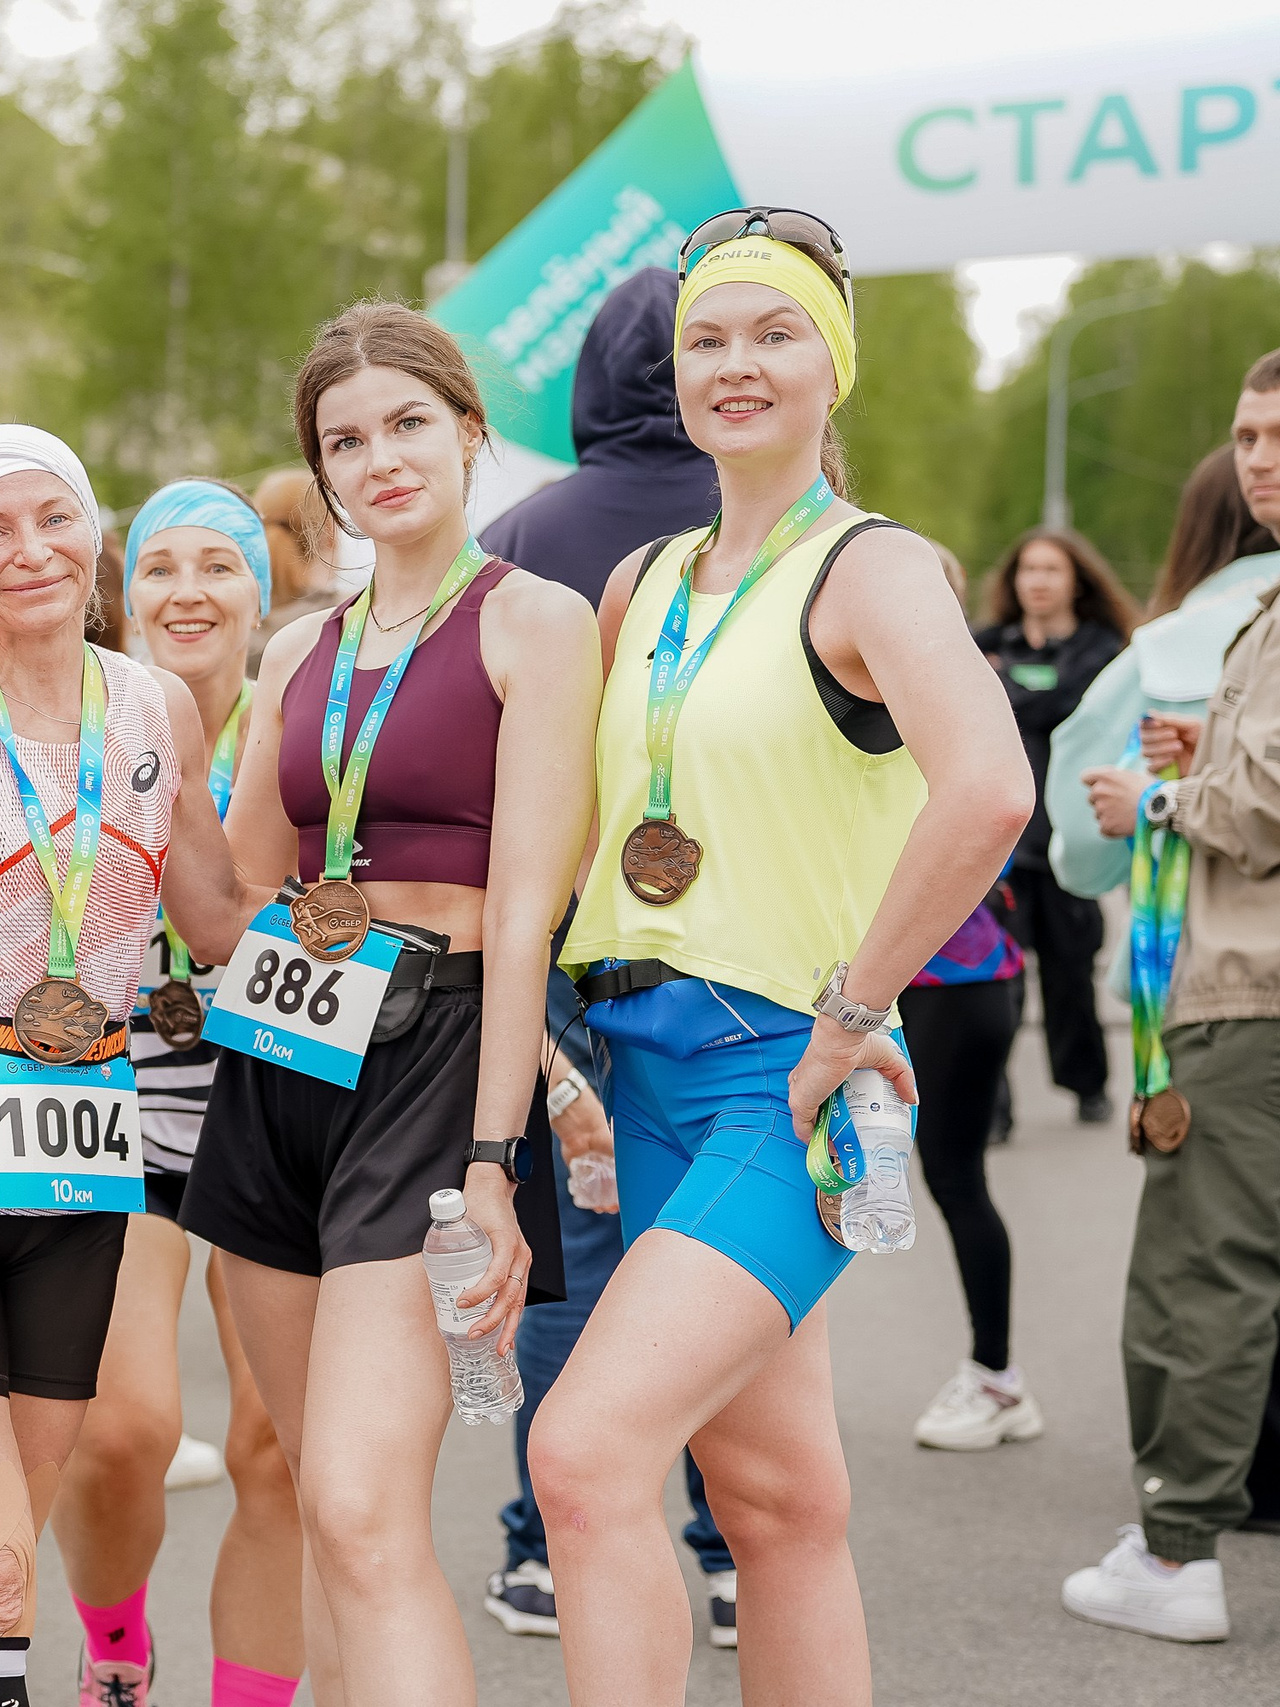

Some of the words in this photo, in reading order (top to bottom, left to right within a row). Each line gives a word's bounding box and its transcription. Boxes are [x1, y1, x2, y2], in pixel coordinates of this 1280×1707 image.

[898, 85, 1279, 191] СТАР
[794, 506, 812, 523] 185
[391, 657, 405, 678] Utair
[684, 650, 701, 678] СБЕР
[656, 664, 669, 693] СБЕР
[363, 710, 380, 739] СБЕР
[328, 725, 338, 752] СБЕР
[84, 771, 95, 792] Utair
[345, 787, 356, 808] 185
[33, 819, 50, 849] СБЕР
[80, 828, 92, 859] СБЕР
[72, 871, 83, 892] 185
[67, 893, 78, 914] лет
[339, 918, 362, 928] СБЕР
[246, 948, 345, 1026] 886
[724, 1033, 743, 1043] BELT
[20, 1063, 45, 1073] СБЕР
[847, 1157, 858, 1179] Utair
